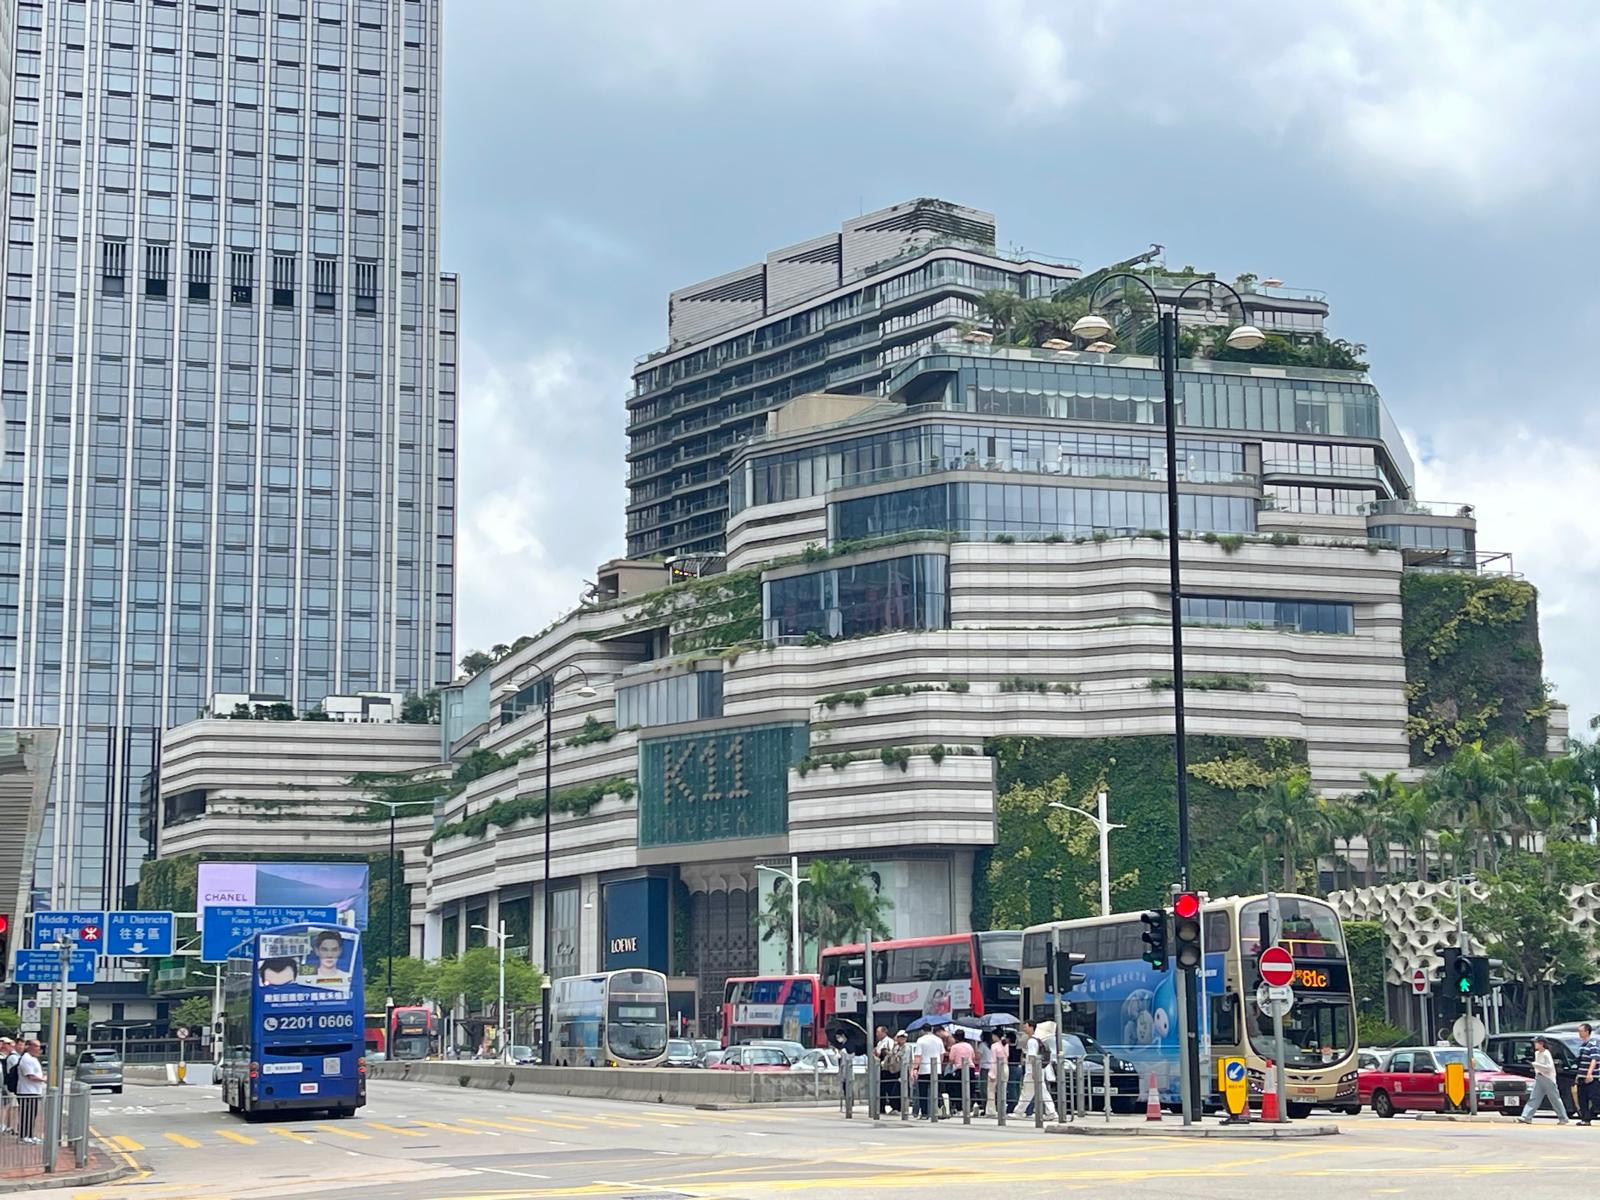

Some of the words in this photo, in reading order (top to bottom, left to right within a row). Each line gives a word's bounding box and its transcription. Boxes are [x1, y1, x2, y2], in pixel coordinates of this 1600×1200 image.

[663, 735, 751, 805] K11
[664, 813, 749, 835] MUSEA
[204, 893, 248, 902] CHANEL
[285, 908, 305, 917] Hong
[307, 908, 327, 918] Kong
[38, 915, 69, 924] Middle
[71, 915, 98, 924] Road
[112, 915, 125, 924] All
[130, 915, 169, 924] Districts
[254, 917, 272, 925] Tong
[119, 927, 160, 940] 往各區
[610, 937, 637, 953] LOEWE
[280, 1016, 313, 1030] 2201
[318, 1014, 353, 1028] 0606
